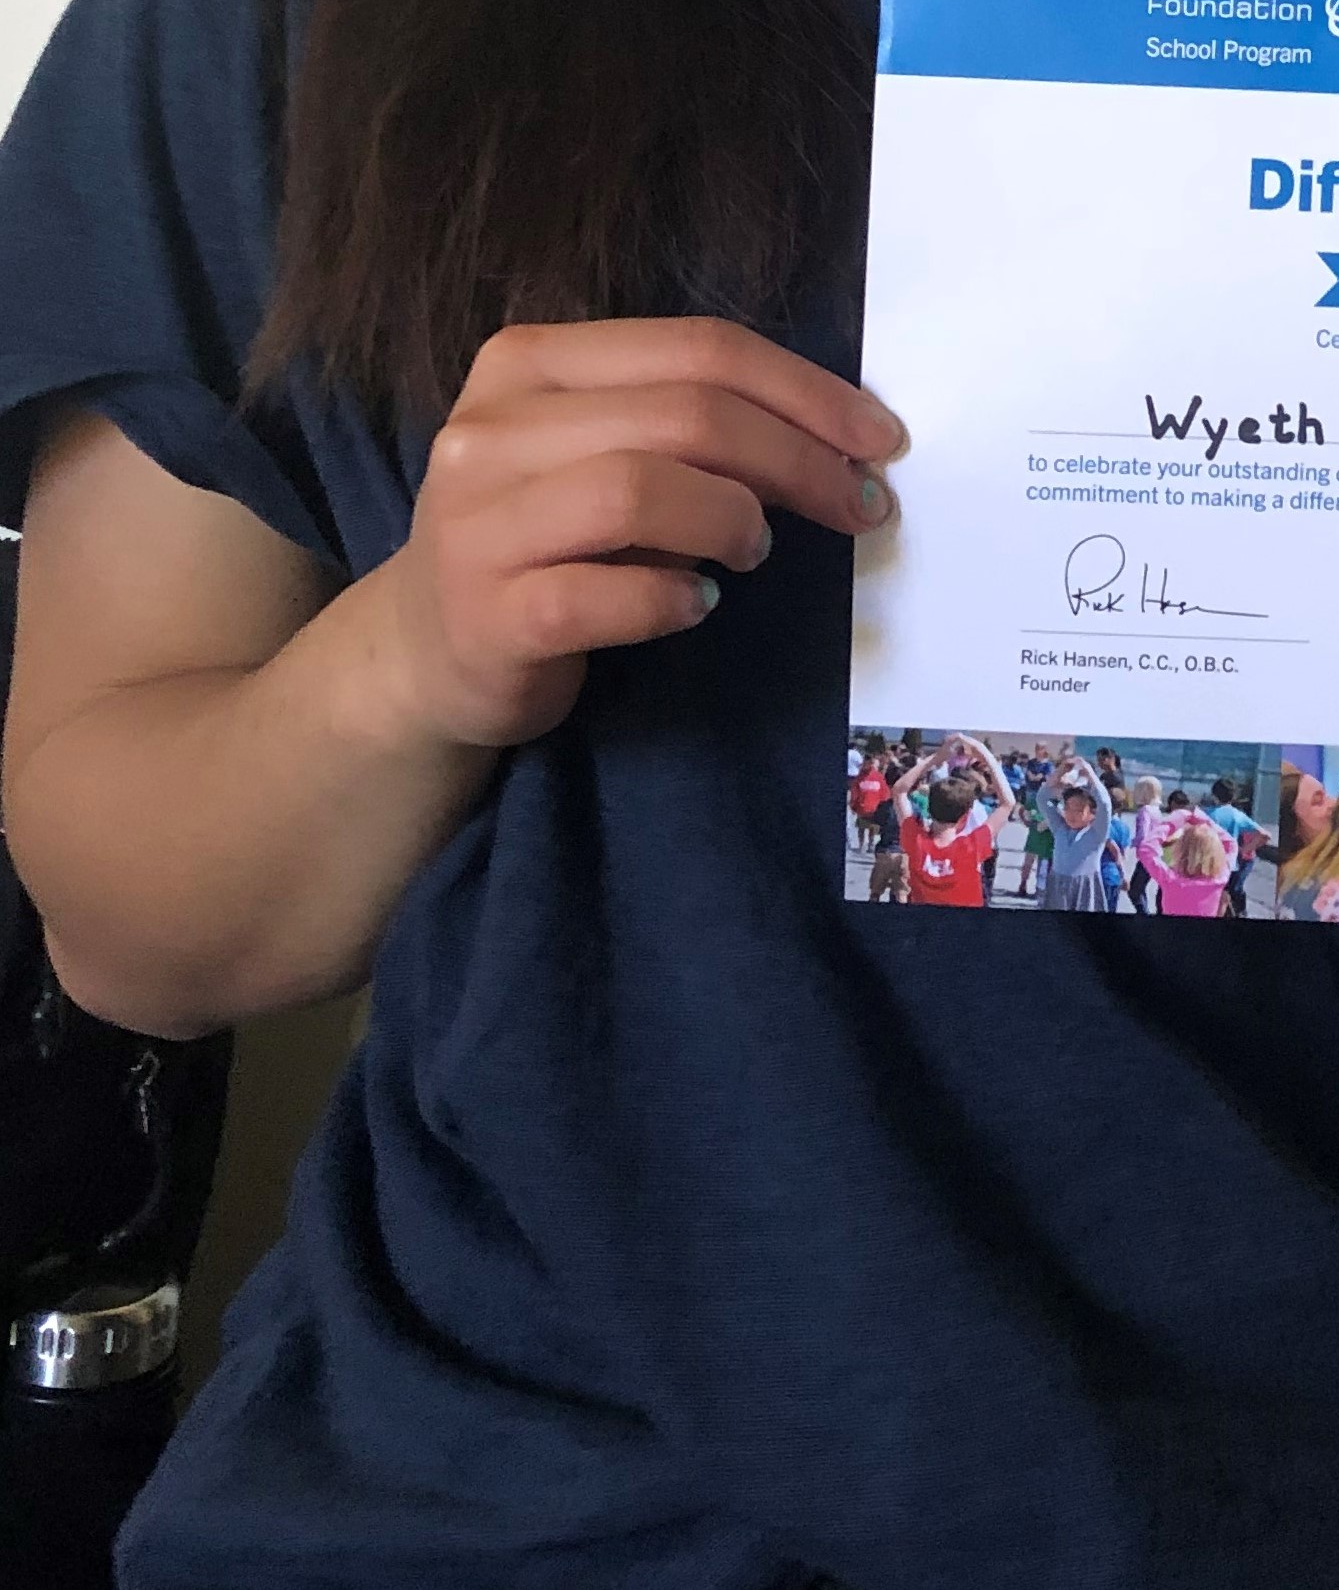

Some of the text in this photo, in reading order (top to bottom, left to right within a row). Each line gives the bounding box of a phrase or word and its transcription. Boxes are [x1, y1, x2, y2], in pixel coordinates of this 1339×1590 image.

[1146, 36, 1312, 66] School Program
[1145, 394, 1325, 460] Wyeth
[1028, 454, 1047, 472] to
[1054, 455, 1151, 475] celebrate
[1157, 460, 1202, 480] your
[1208, 461, 1330, 486] outstanding
[1026, 484, 1158, 505] commitment
[1165, 487, 1184, 505] to
[1191, 488, 1266, 512] making
[1272, 494, 1283, 508] a
[1021, 649, 1239, 673] Rick Hansen, C.C., O.B.C.
[1021, 675, 1091, 693] Founder
